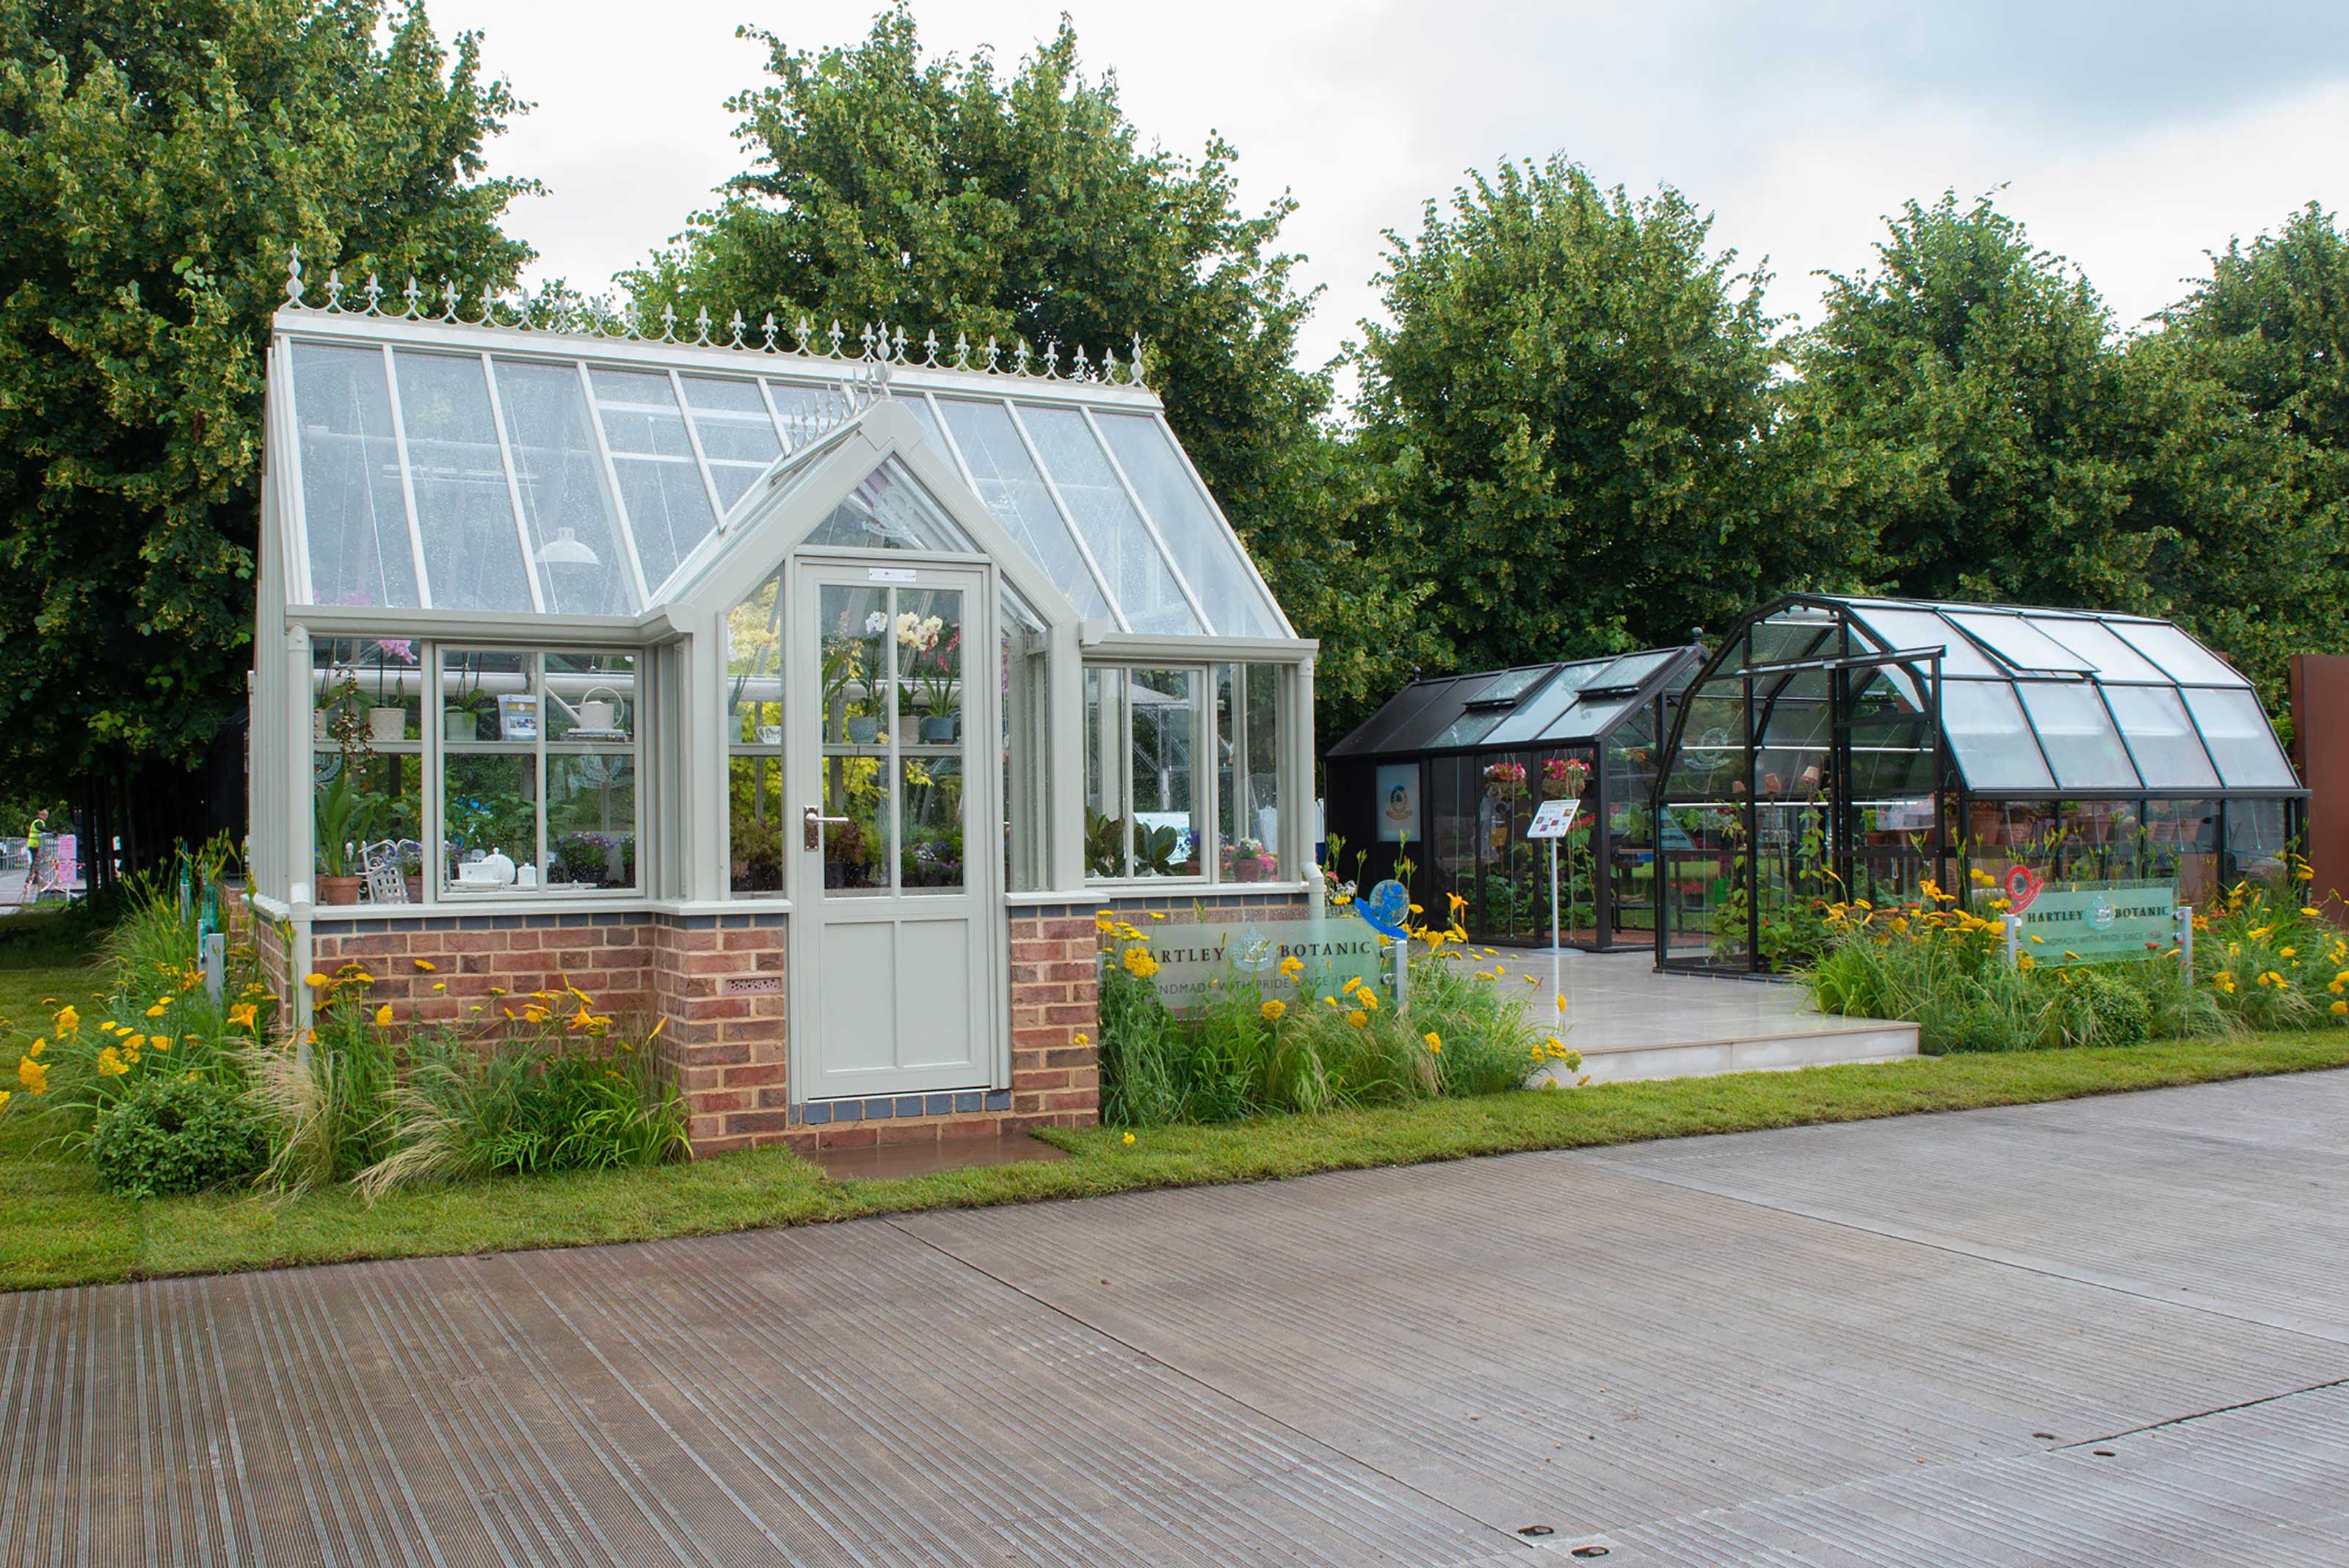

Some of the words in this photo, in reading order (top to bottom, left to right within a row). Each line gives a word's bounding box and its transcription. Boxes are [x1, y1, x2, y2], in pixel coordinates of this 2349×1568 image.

[2027, 910, 2083, 923] HARTLEY
[2114, 905, 2169, 918] BOTANIC
[1147, 946, 1225, 963] ARTLEY
[1280, 941, 1371, 958] BOTANIC
[1159, 982, 1208, 995] NDMAD
[1256, 978, 1289, 990] PRIDE
